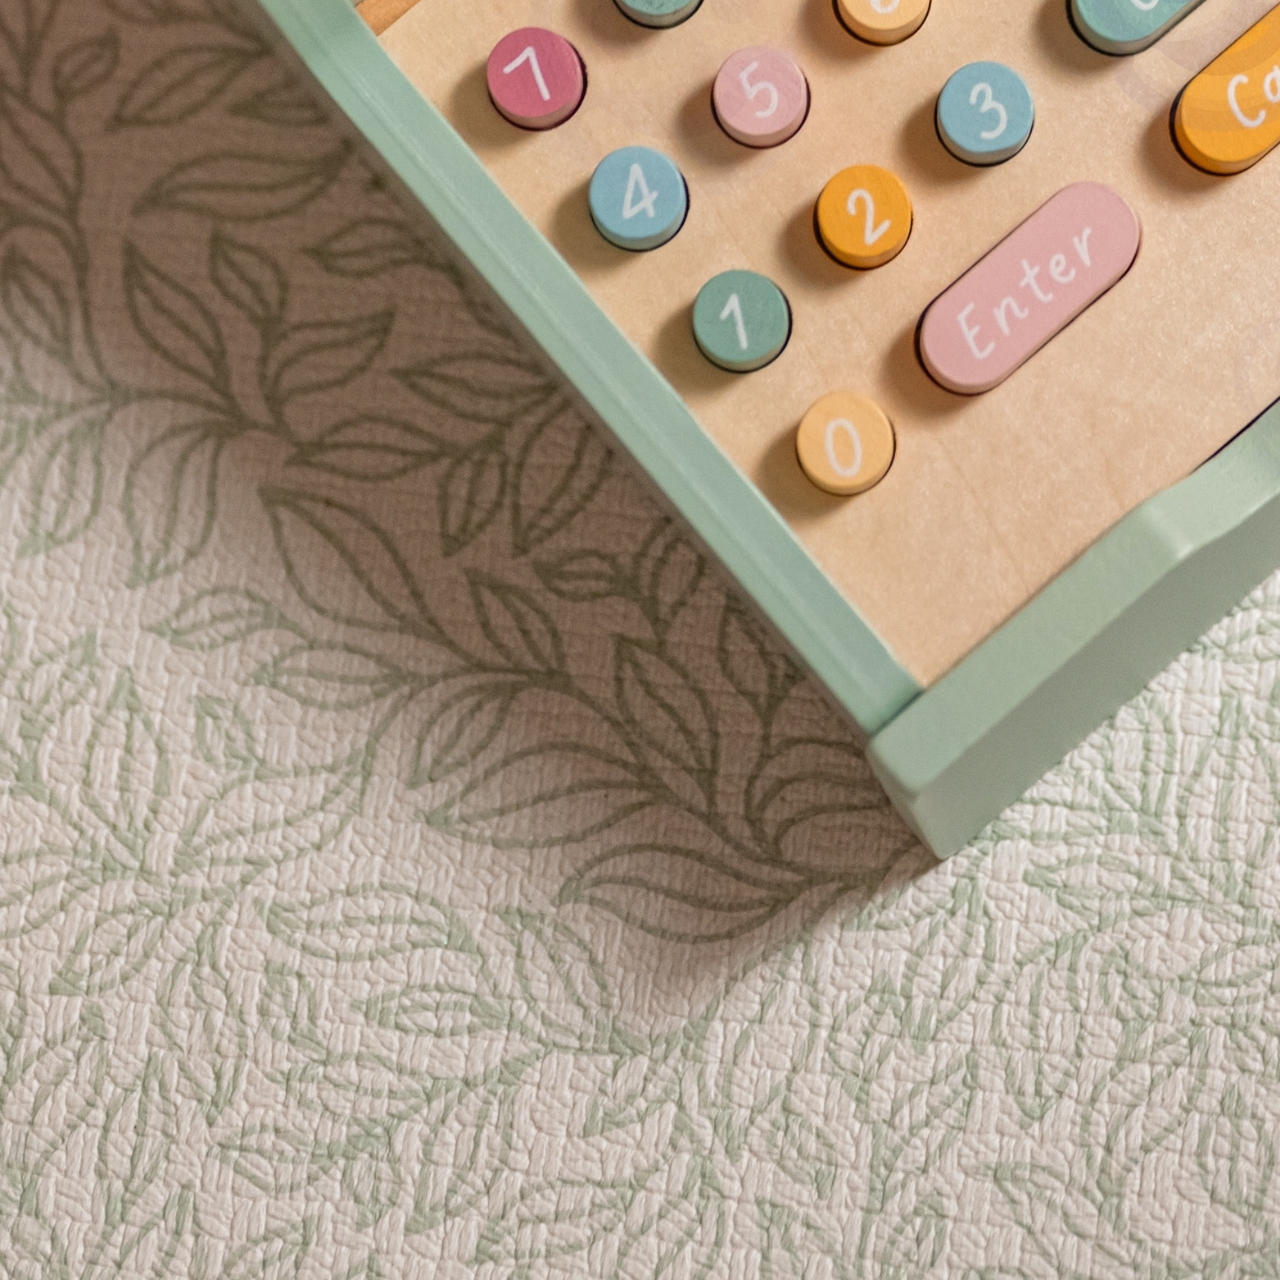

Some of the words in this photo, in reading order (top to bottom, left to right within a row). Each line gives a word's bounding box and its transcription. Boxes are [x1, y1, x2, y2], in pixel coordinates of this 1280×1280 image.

[502, 45, 552, 101] 7
[620, 162, 660, 221] 4
[738, 60, 780, 119] 5
[718, 292, 750, 351] 1
[845, 187, 892, 247] 2
[968, 81, 1010, 140] 3
[955, 224, 1095, 361] Enter
[823, 417, 863, 478] 0
